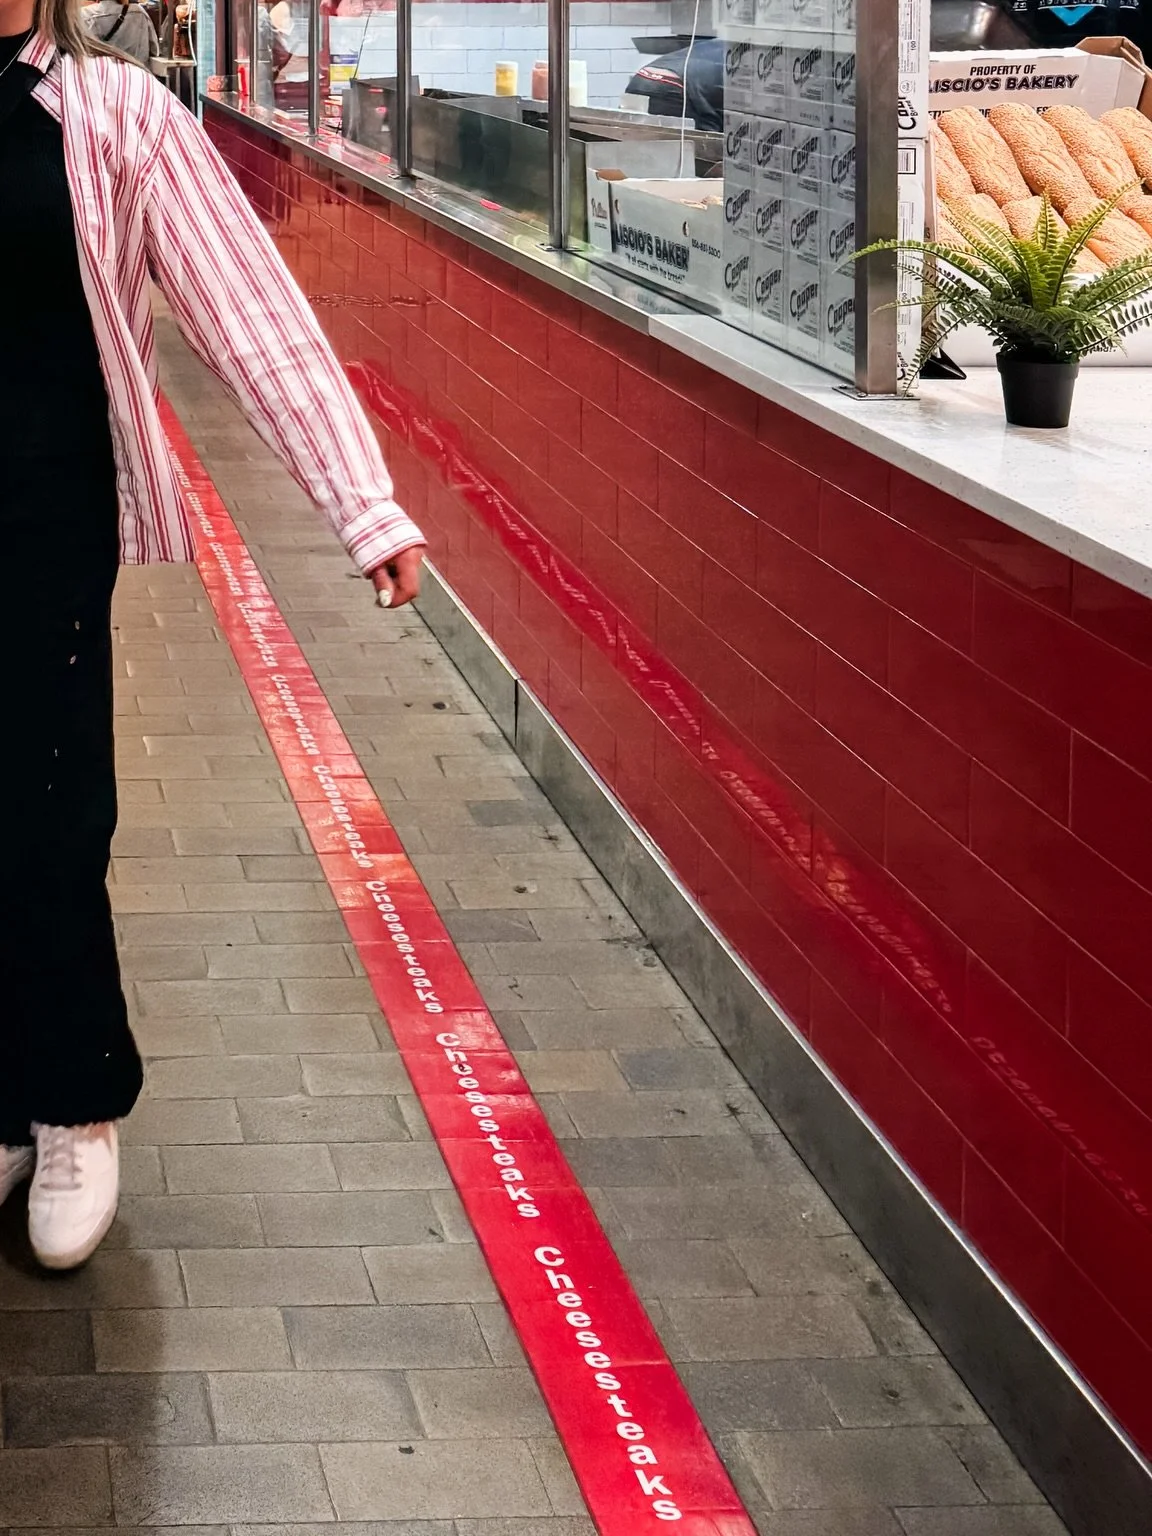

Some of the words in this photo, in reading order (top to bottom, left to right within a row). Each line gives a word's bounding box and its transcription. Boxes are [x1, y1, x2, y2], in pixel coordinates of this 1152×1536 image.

[969, 64, 1023, 76] PROPERTY
[1023, 64, 1037, 74] OF
[1004, 74, 1079, 90] BAKERY
[791, 136, 819, 174] Cooper
[831, 145, 856, 184] Coope
[755, 198, 782, 235] Cooper
[790, 209, 819, 246] Cooper
[614, 223, 653, 257] LISCIO'S
[654, 236, 689, 271] BAKER
[829, 221, 855, 259] Coope
[754, 269, 782, 304] Cooper
[789, 283, 819, 319] Cooper
[311, 765, 374, 869] Cheesesteaks
[366, 880, 443, 1014] Cheesesteaks
[435, 1032, 541, 1218] Cheesesteaks
[533, 1245, 683, 1522] Cheesesteaks
